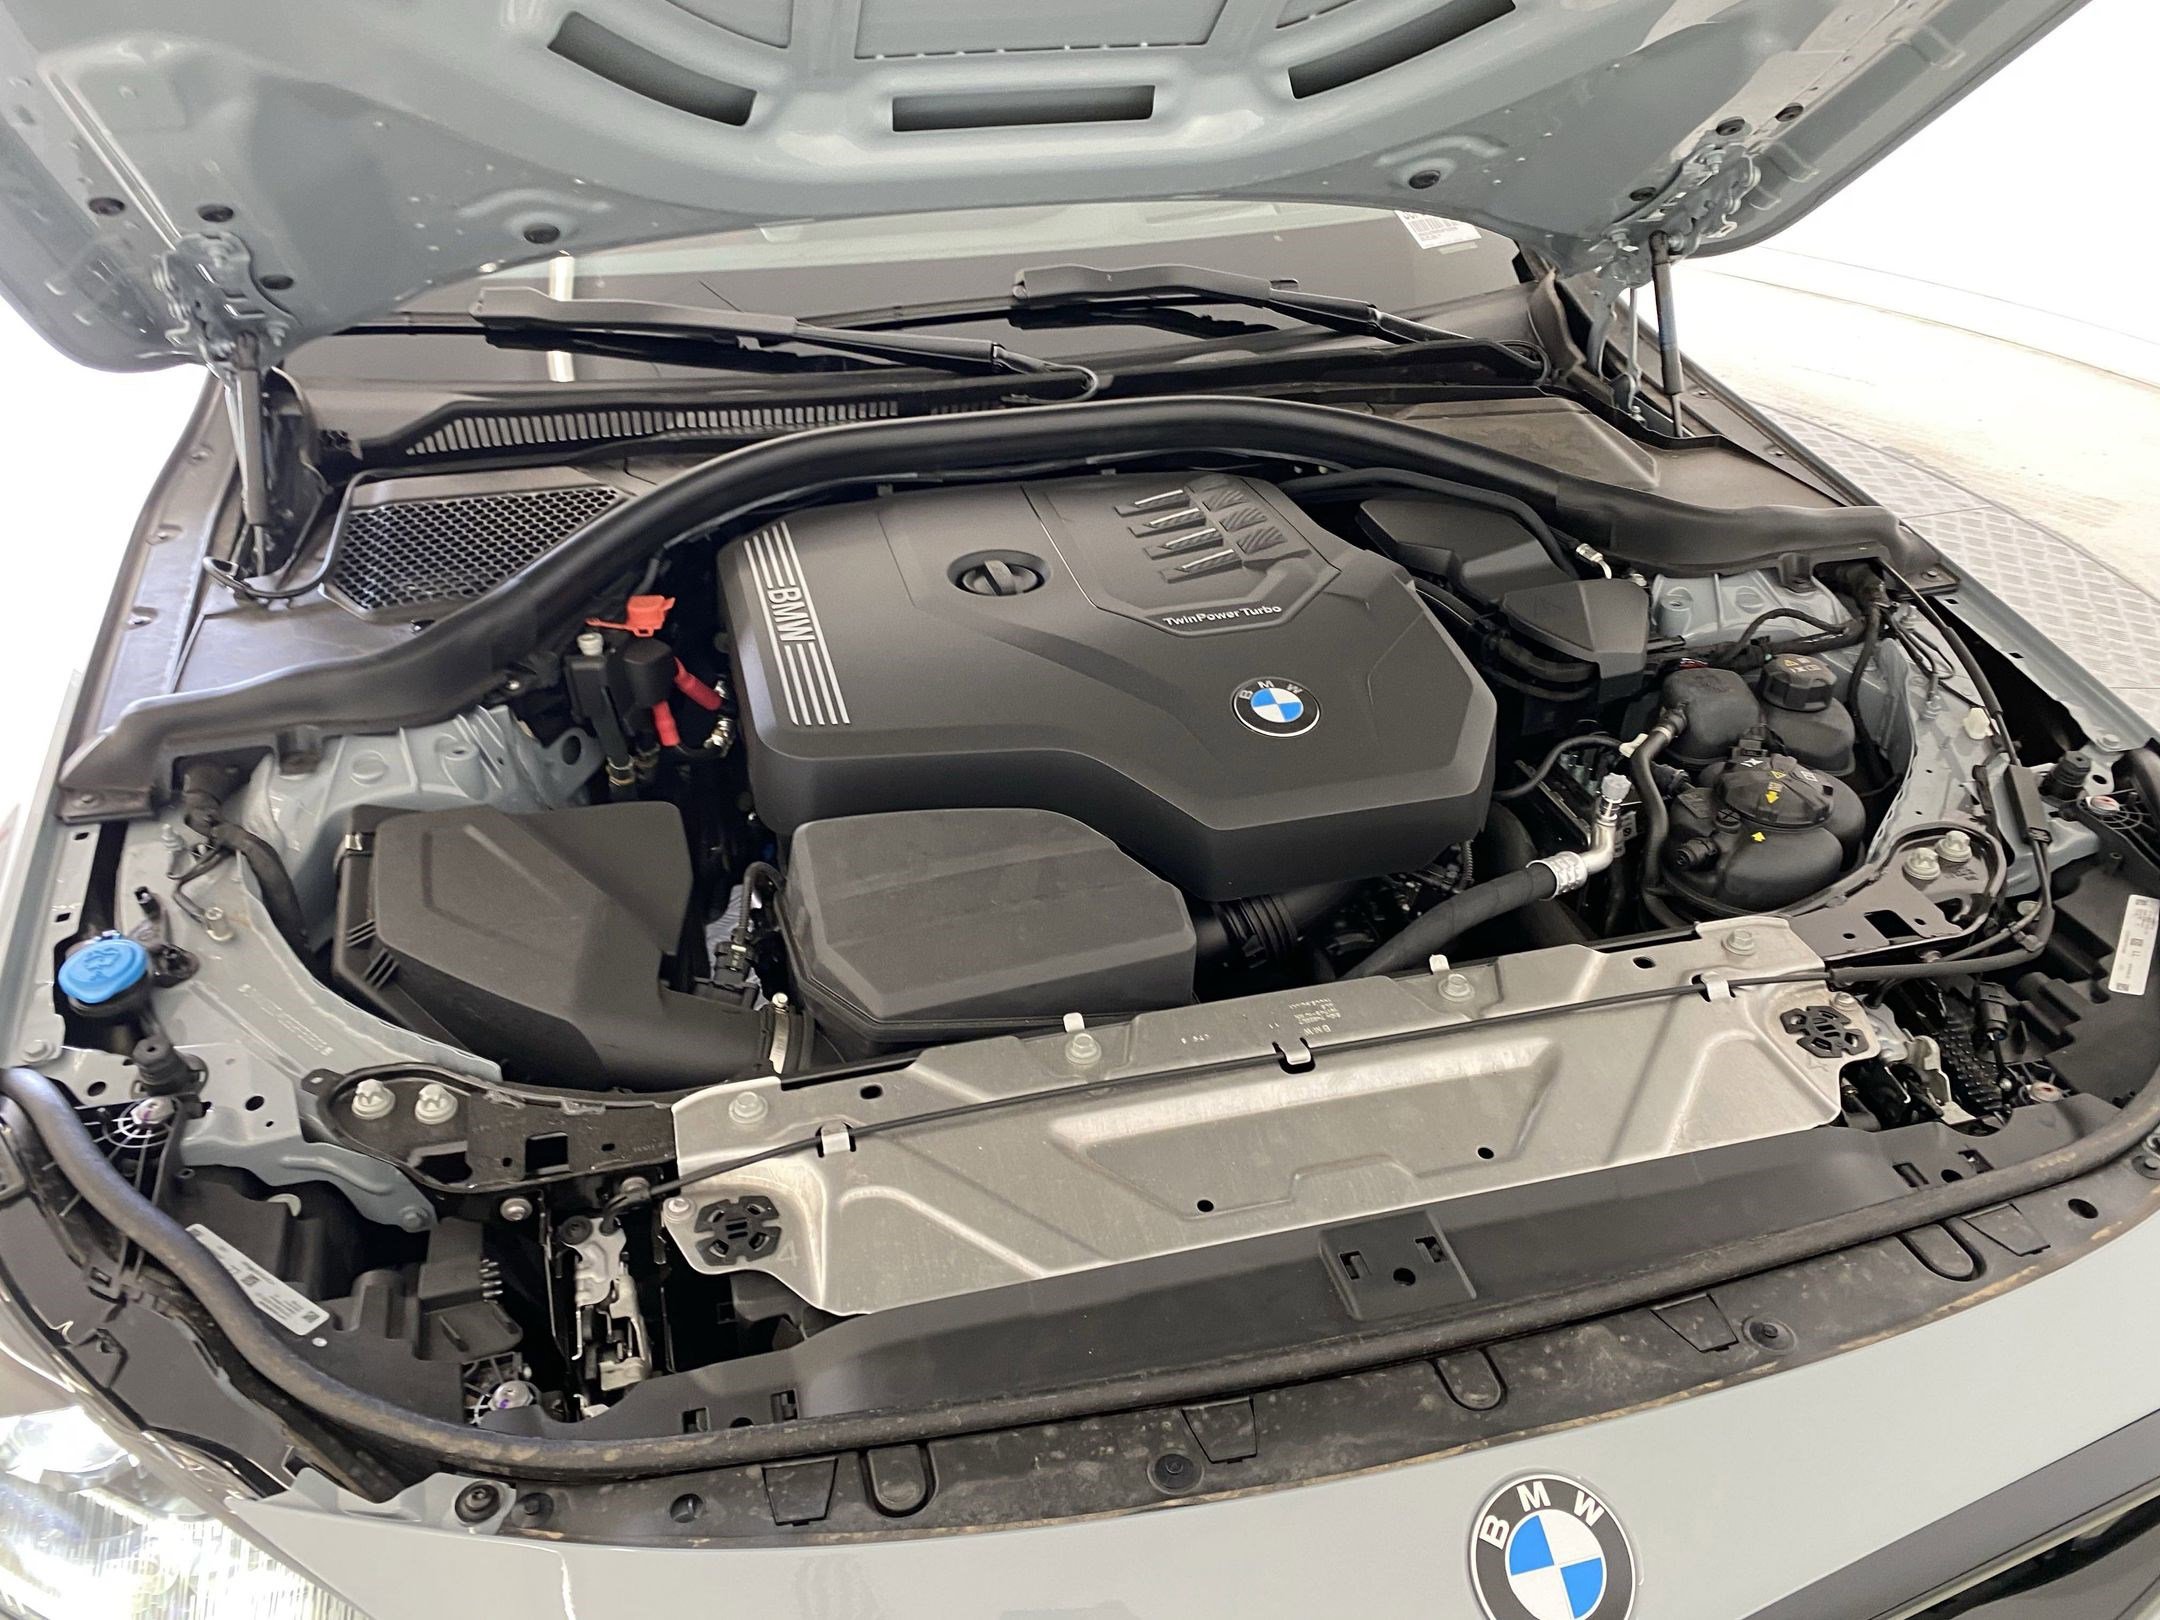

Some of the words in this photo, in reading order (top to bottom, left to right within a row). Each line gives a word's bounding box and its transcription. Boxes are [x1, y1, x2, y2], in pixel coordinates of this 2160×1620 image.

[767, 587, 816, 641] BMW
[1163, 610, 1239, 626] TwinPower
[1239, 605, 1282, 617] Turbo
[1239, 680, 1303, 700] BMW
[1479, 1480, 1605, 1550] BMW
